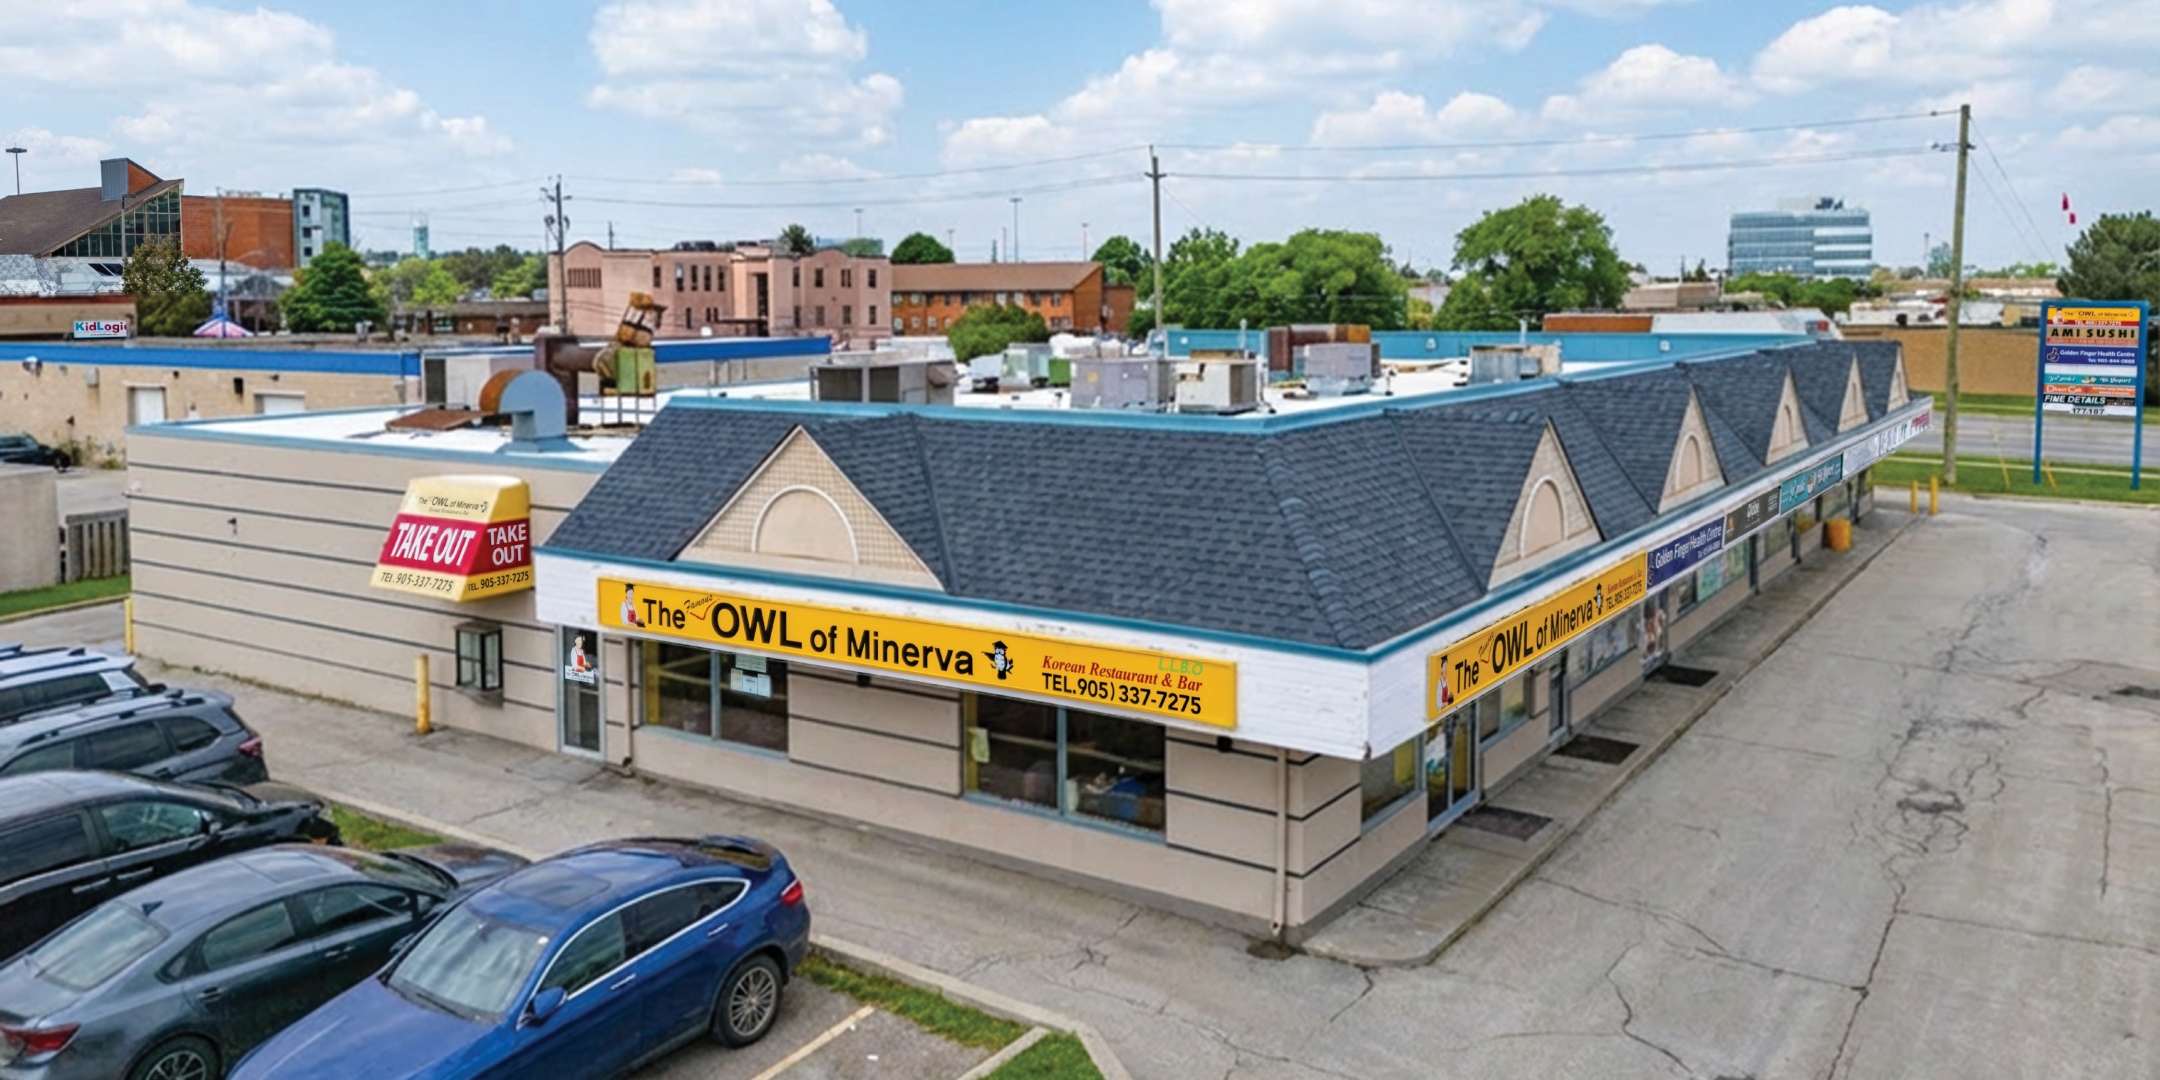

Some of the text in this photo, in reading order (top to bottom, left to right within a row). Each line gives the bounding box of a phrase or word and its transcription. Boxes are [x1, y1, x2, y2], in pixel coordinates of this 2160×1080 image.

[2051, 328, 2134, 338] AMI SUSHI
[2044, 395, 2065, 403] FINE
[2068, 396, 2106, 404] DETAILS
[432, 497, 448, 507] OWL
[456, 501, 479, 510] Minerva
[390, 522, 476, 566] TAKE OUT
[487, 524, 526, 546] TAKE
[492, 544, 524, 566] OUT
[1656, 548, 1673, 569] Golden
[1674, 542, 1689, 559] Finger
[1690, 530, 1706, 550] Health
[1707, 526, 1722, 542] Centre
[381, 572, 454, 592] TEL. 905-337-7275
[481, 571, 529, 589] 905-337-7275
[684, 594, 713, 614] Famous
[642, 598, 974, 676] The OWL of Minerva
[1455, 600, 1592, 694] The OWL of Minerva
[1042, 655, 1202, 692] Korean Restaurant & Bar
[1158, 657, 1203, 676] L.L.B.O
[1118, 685, 1201, 714] 337-7275
